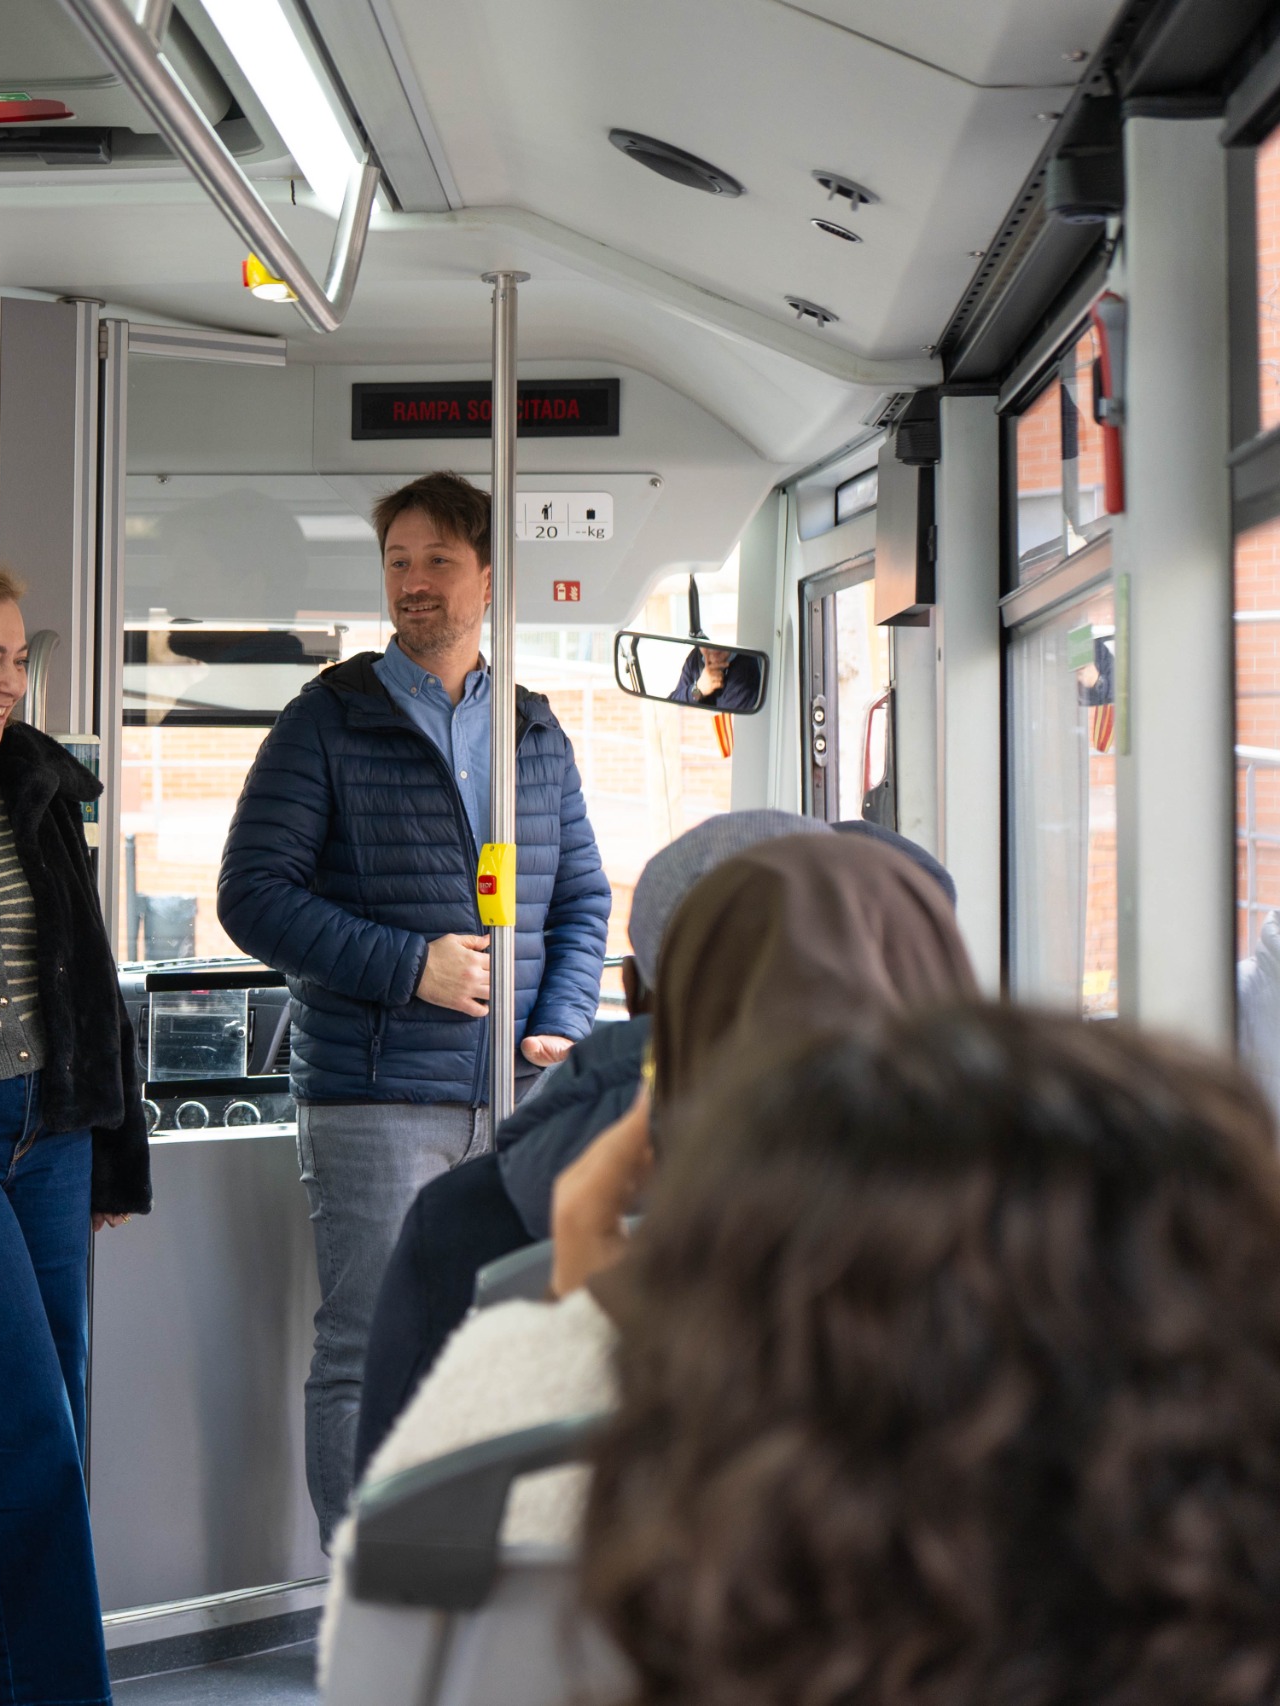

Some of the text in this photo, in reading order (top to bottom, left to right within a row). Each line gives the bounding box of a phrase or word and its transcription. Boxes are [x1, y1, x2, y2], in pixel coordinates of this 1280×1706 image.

[393, 399, 580, 421] RAMPA SOCITADA
[535, 526, 558, 539] 20
